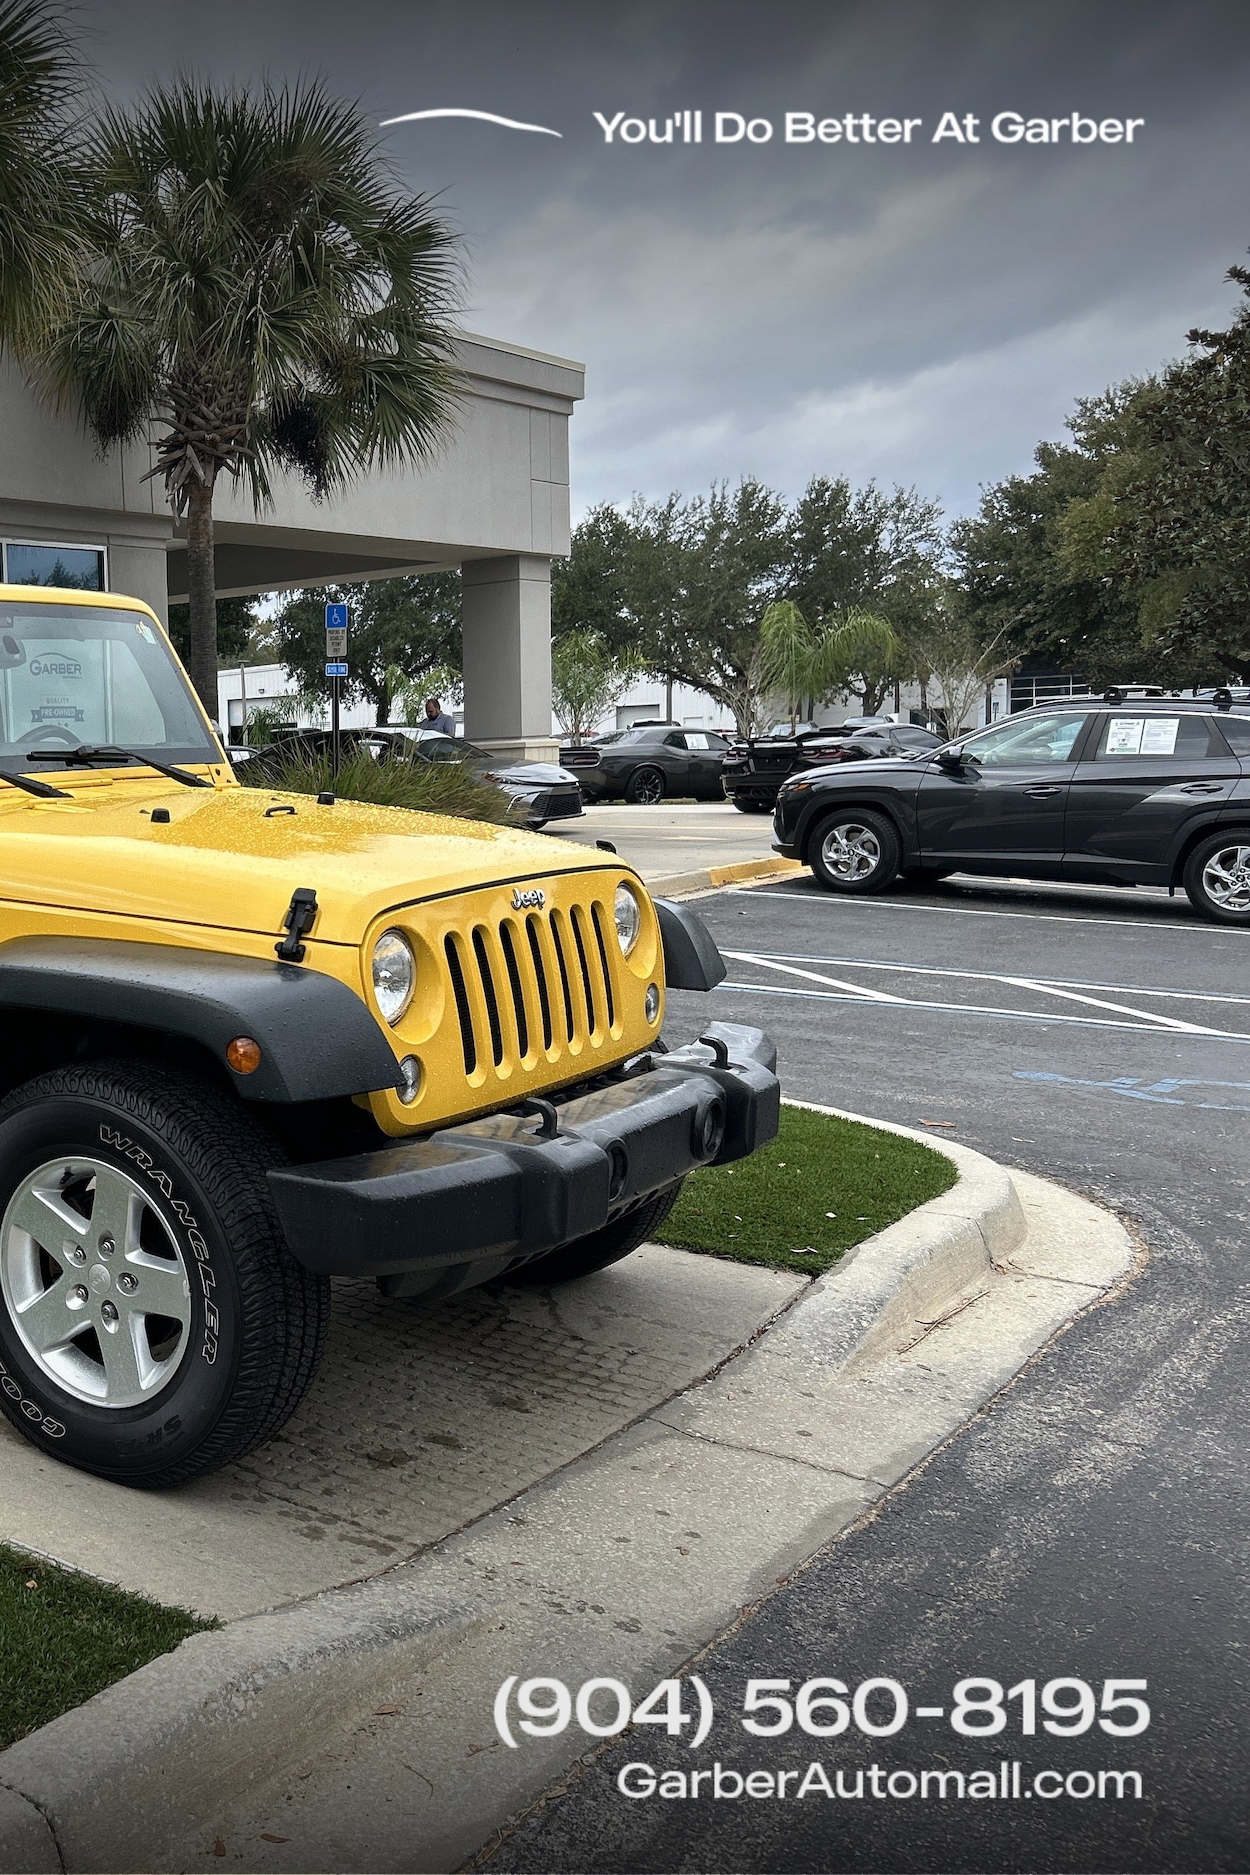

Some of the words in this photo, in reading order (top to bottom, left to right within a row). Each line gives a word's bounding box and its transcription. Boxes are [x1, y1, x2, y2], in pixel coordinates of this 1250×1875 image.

[30, 659, 82, 676] GARBER
[510, 887, 546, 911] Jeep
[99, 1123, 221, 1366] WRANGLER
